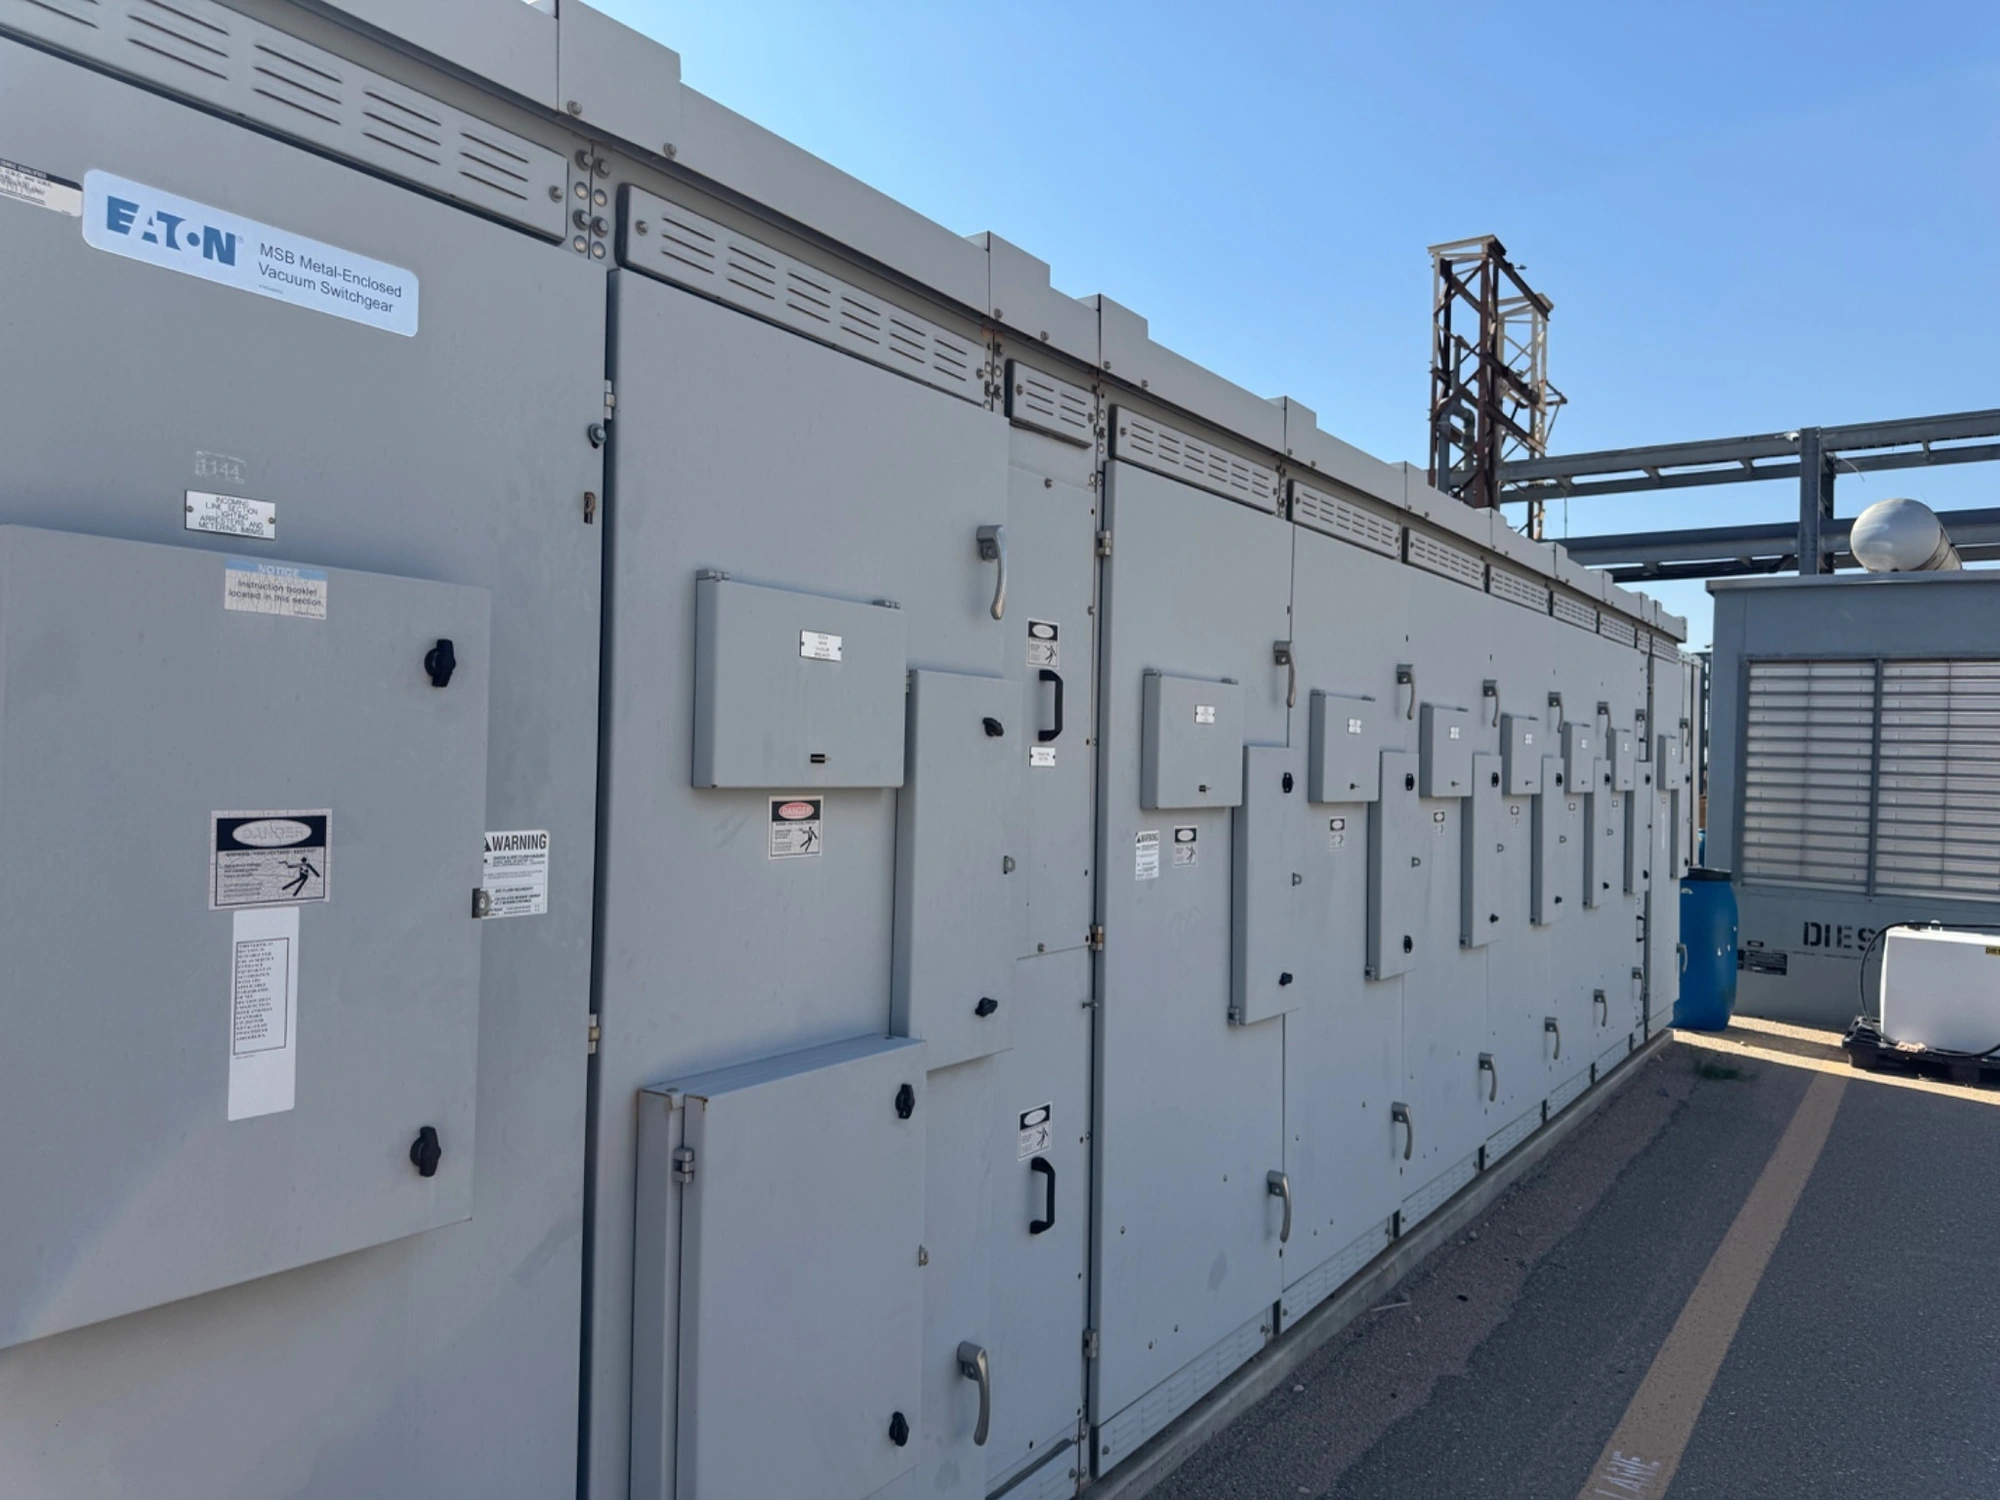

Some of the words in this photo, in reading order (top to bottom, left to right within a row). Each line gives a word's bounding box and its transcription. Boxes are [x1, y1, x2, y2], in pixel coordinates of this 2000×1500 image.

[107, 195, 236, 267] EATON
[260, 243, 295, 265] MSB
[300, 255, 402, 298] Metal-Enclosed
[258, 262, 316, 291] Vacuum
[320, 281, 394, 314] Switchgear
[205, 502, 221, 511] LINE
[228, 503, 259, 515] SECTION
[249, 521, 264, 530] AND
[227, 589, 262, 600] located
[264, 593, 272, 601] in
[274, 594, 290, 604] this
[237, 580, 284, 593] Instruction
[286, 586, 318, 597] booklet
[492, 833, 547, 852] WARNING
